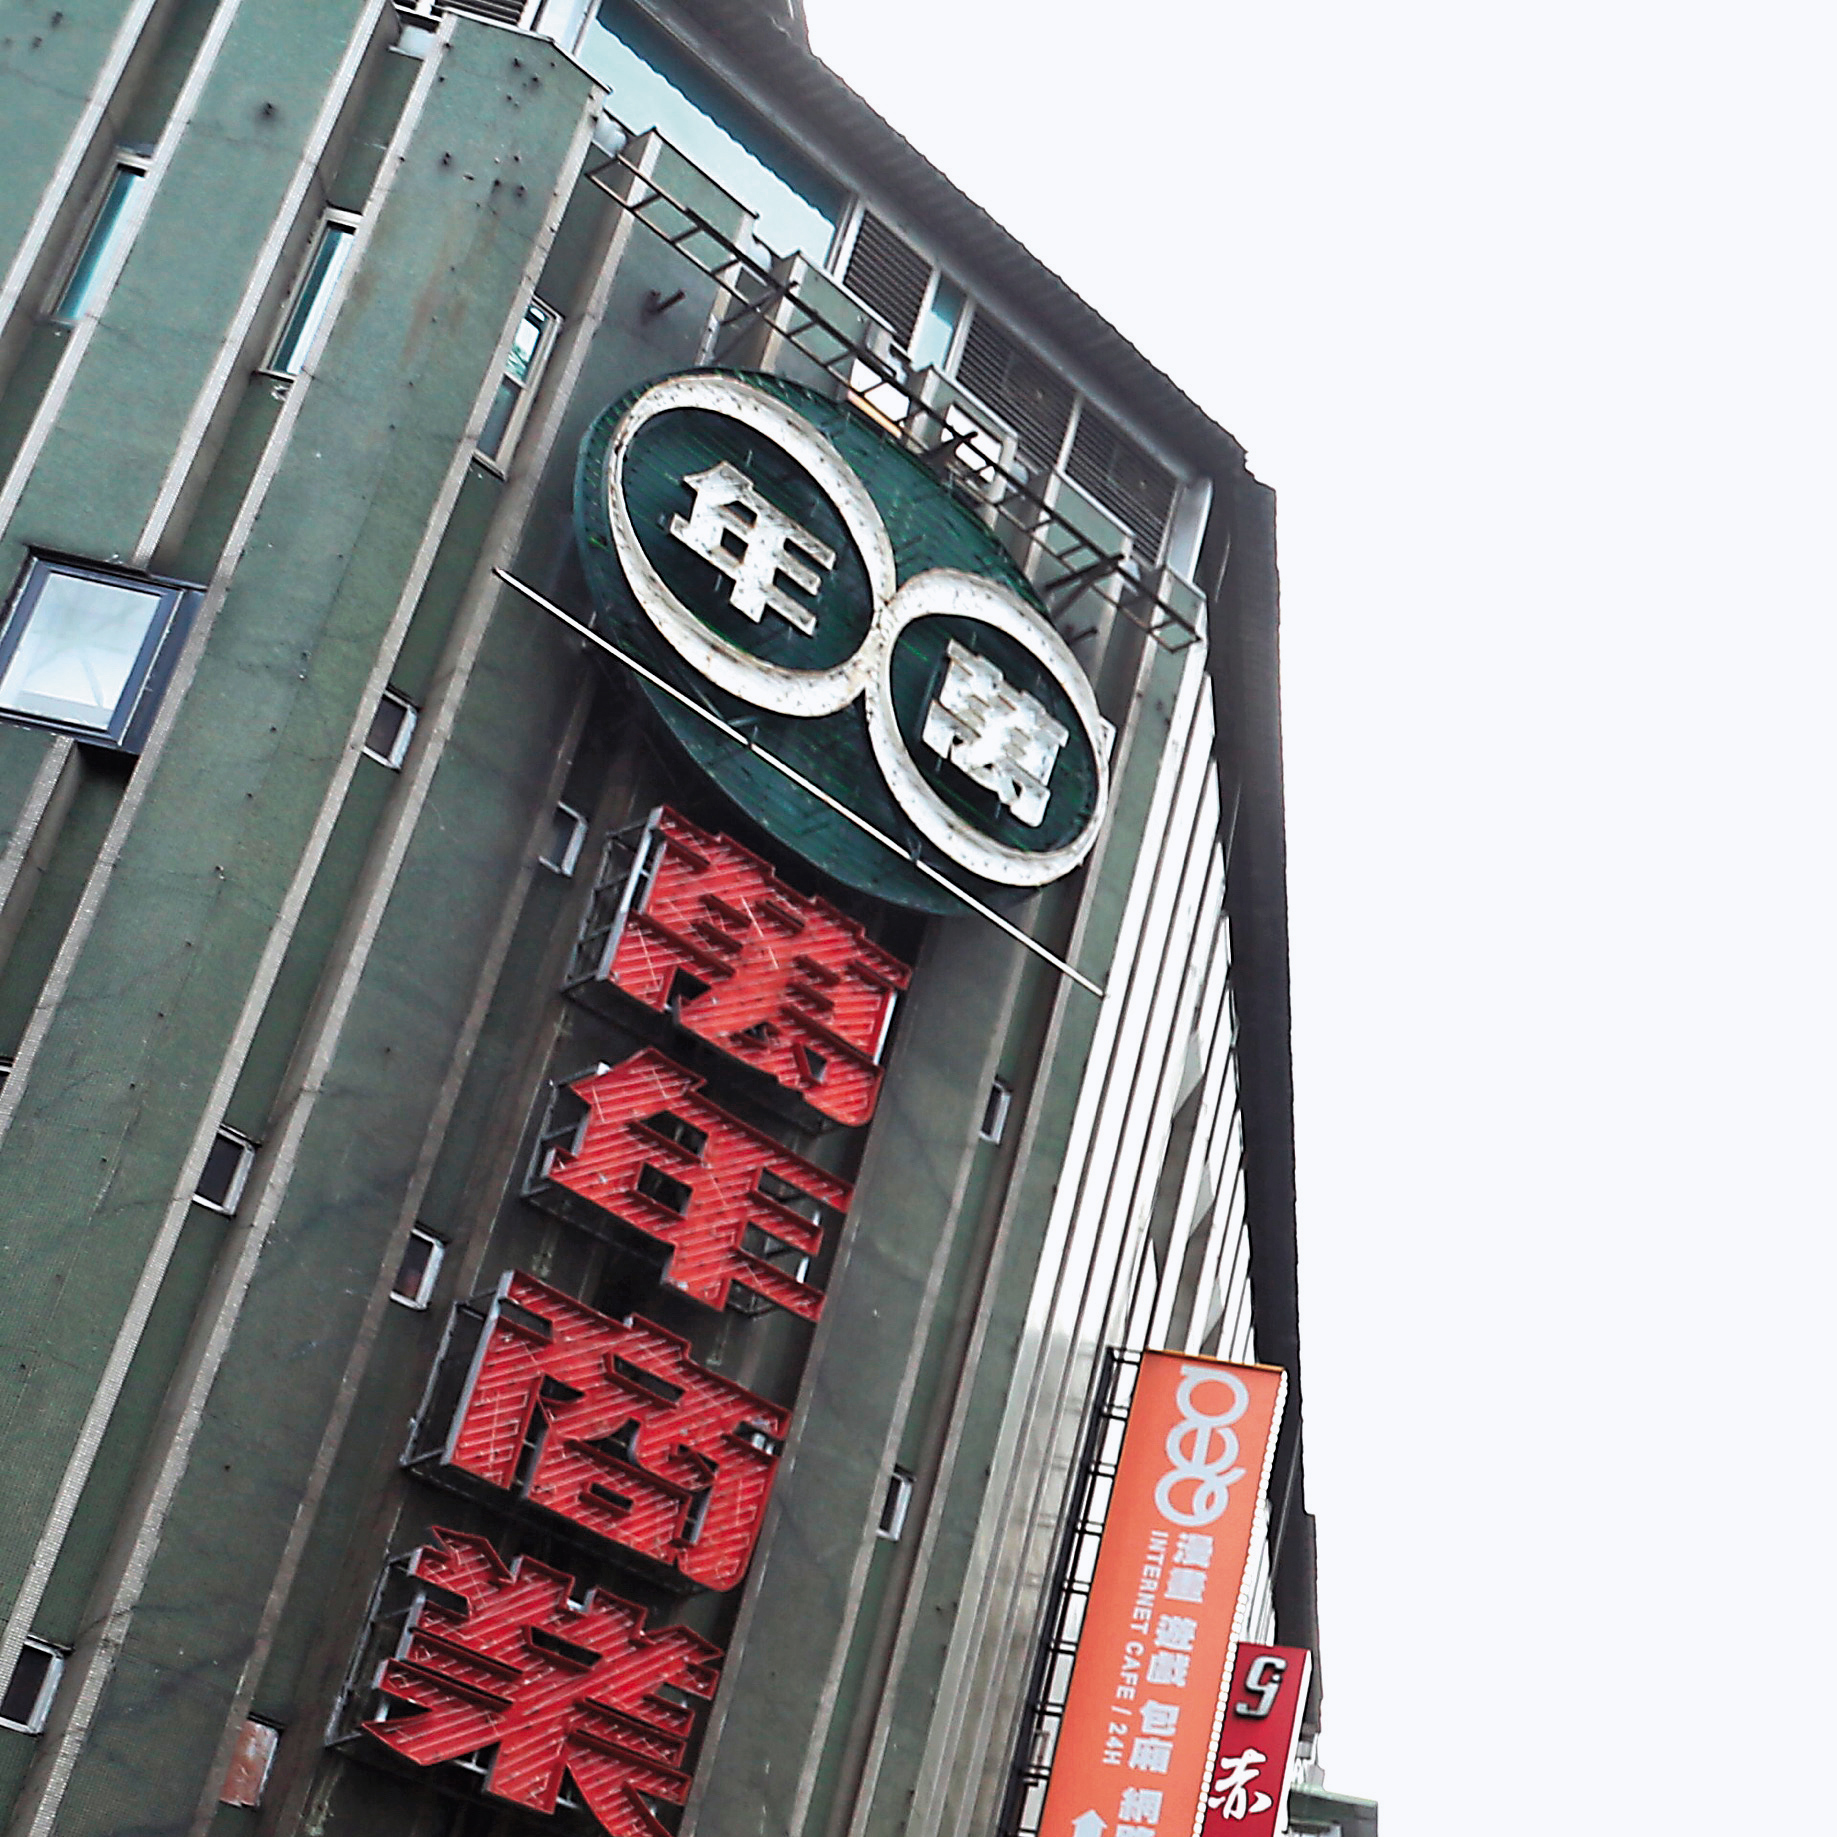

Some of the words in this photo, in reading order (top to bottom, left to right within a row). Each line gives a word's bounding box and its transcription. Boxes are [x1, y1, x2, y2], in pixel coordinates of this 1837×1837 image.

[667, 460, 836, 636] 年
[918, 637, 1072, 826] 萬
[1130, 1529, 1169, 1635] INTERNET
[1115, 1642, 1144, 1697] CAFE
[1102, 1724, 1128, 1766] 24H
